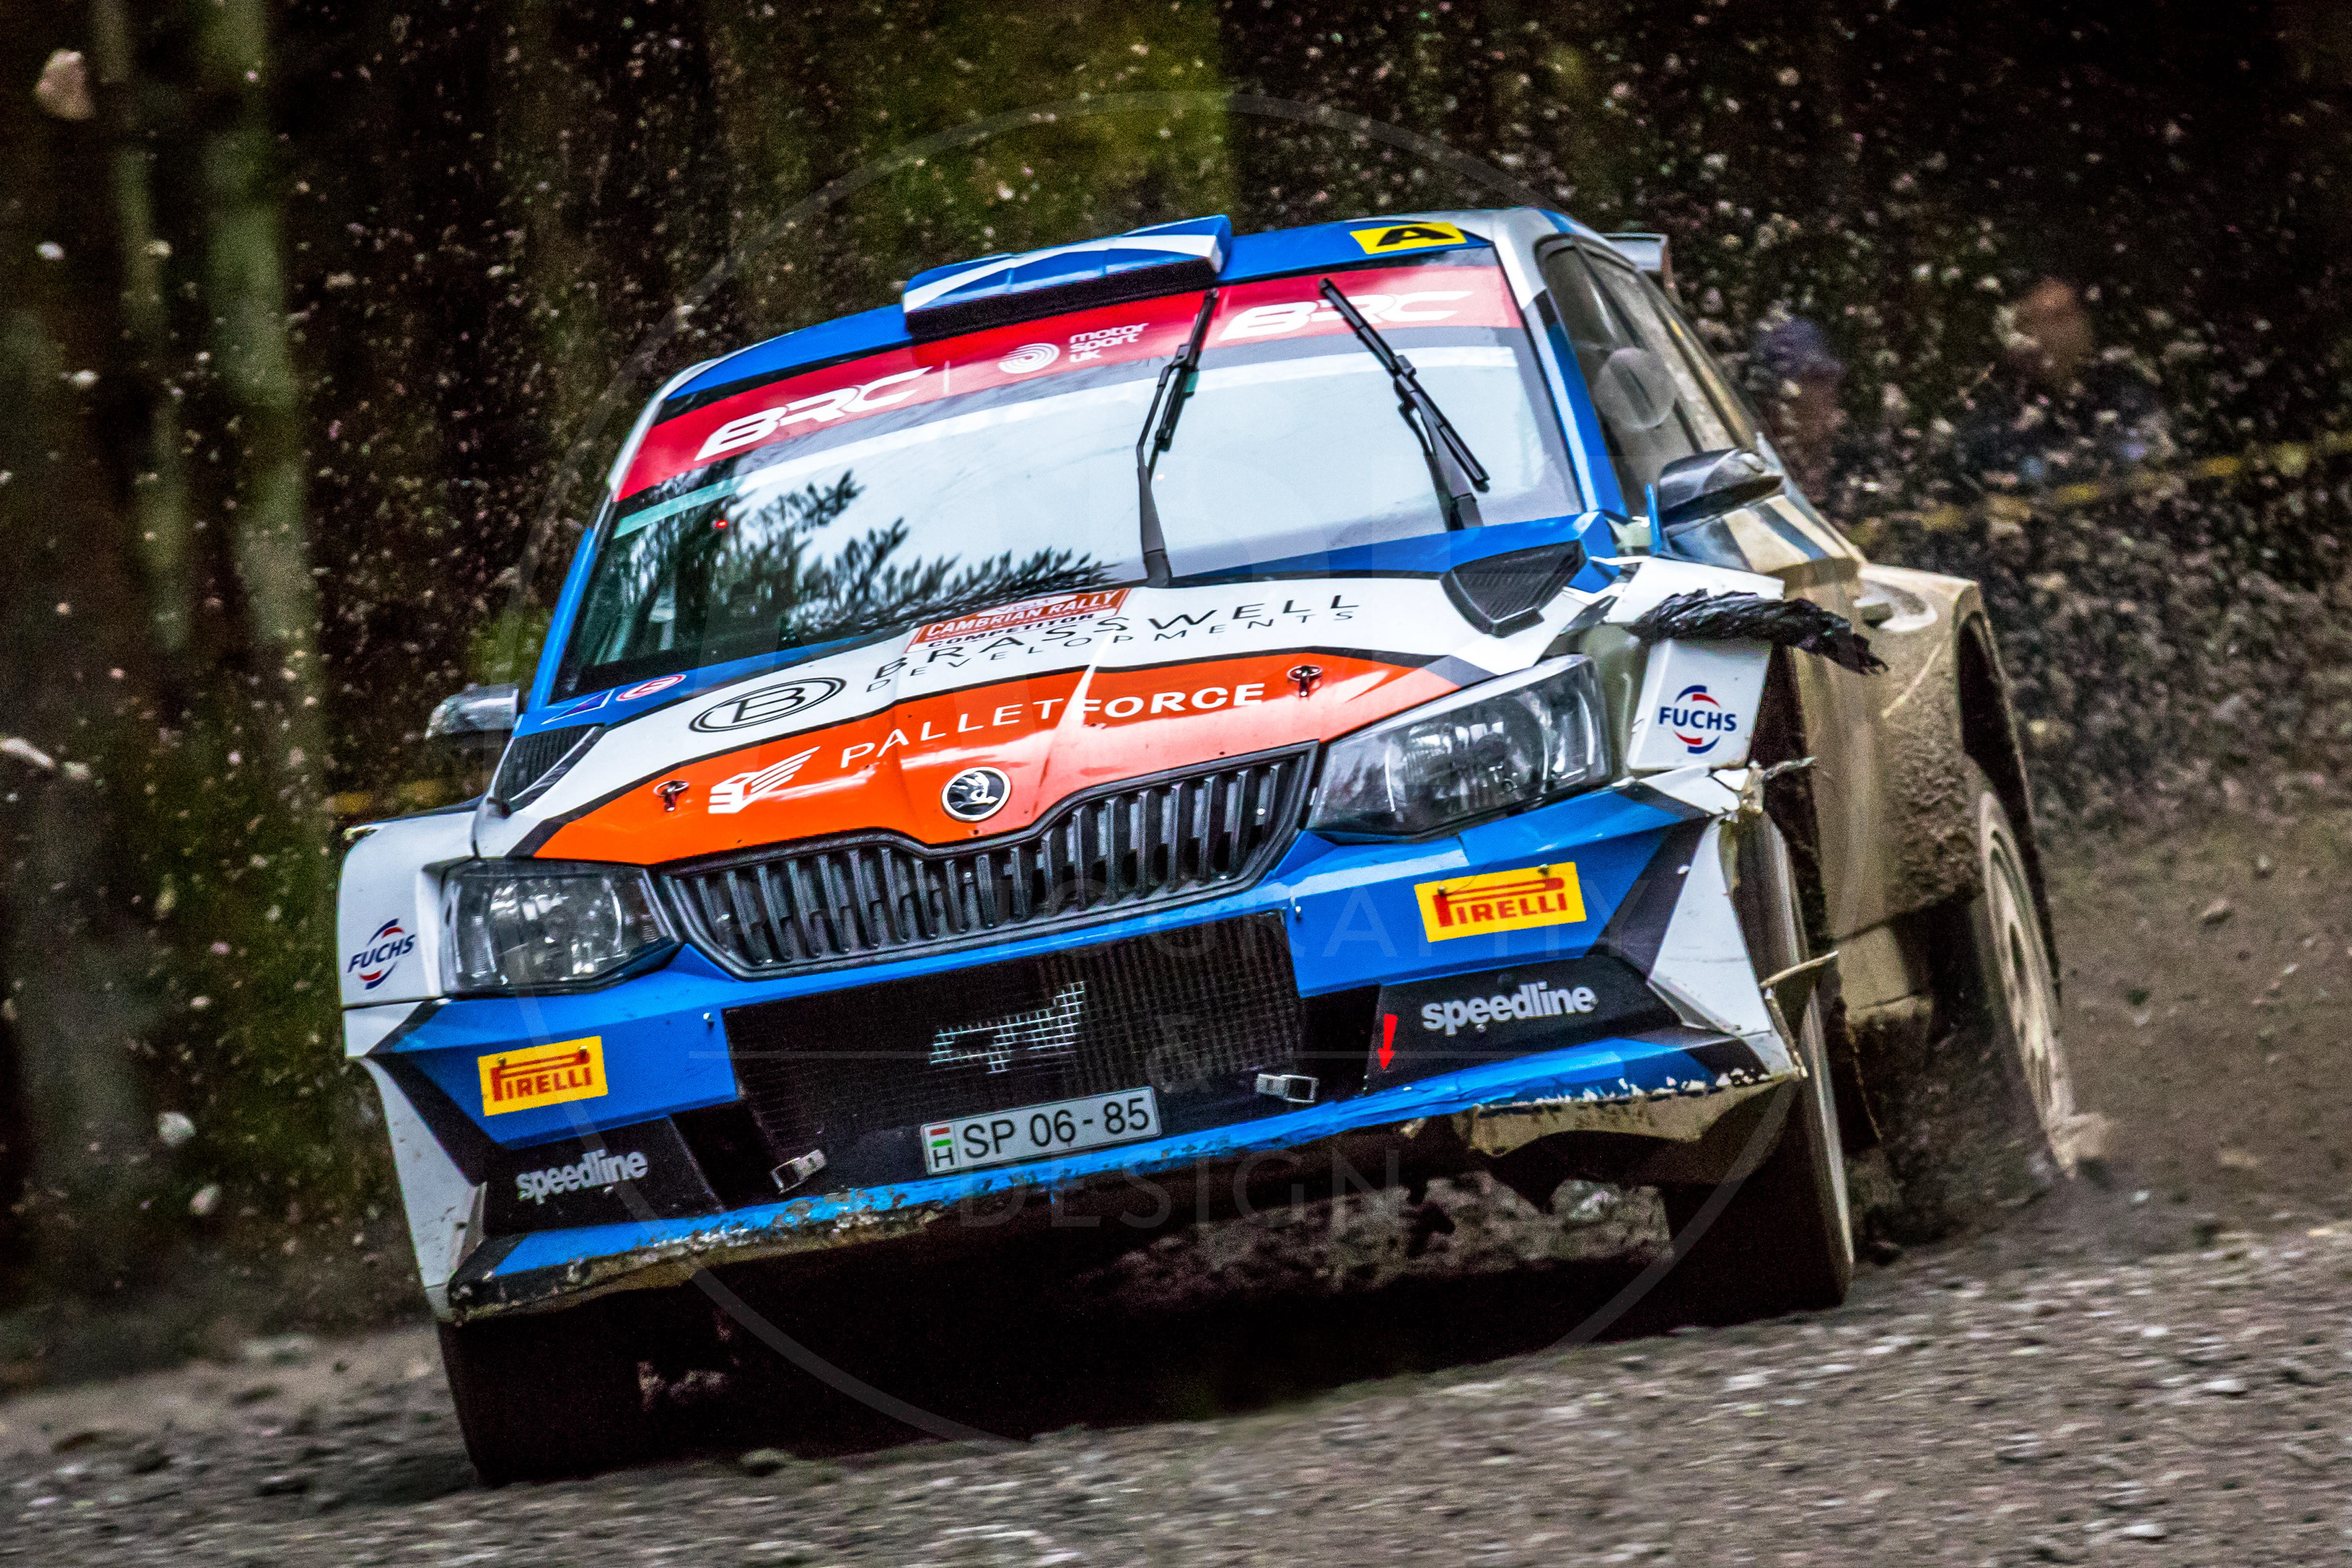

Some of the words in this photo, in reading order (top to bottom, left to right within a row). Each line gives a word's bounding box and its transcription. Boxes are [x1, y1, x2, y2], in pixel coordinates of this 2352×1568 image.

[1377, 225, 1455, 247] A
[1069, 322, 1150, 344] motor
[1069, 333, 1139, 353] sport
[1069, 349, 1103, 363] UK
[694, 366, 933, 461] BRC
[927, 606, 1045, 637] CAMBRIAN
[1047, 590, 1121, 615] RALLY
[928, 614, 1095, 649] COMPETITOR
[866, 611, 1354, 693] DEVELOPMENTS
[875, 594, 1360, 680] BRASSWELL
[840, 682, 1266, 769] PALLETFORCE
[1658, 706, 1737, 732] FUCHS
[1433, 876, 1569, 927] PIRELLI
[347, 933, 417, 973] FUCHS
[1422, 981, 1597, 1036] speedline
[490, 1050, 594, 1102] PIRELLI
[933, 1147, 955, 1168] H
[963, 1118, 1015, 1159] SP
[516, 1148, 648, 1205] speedline
